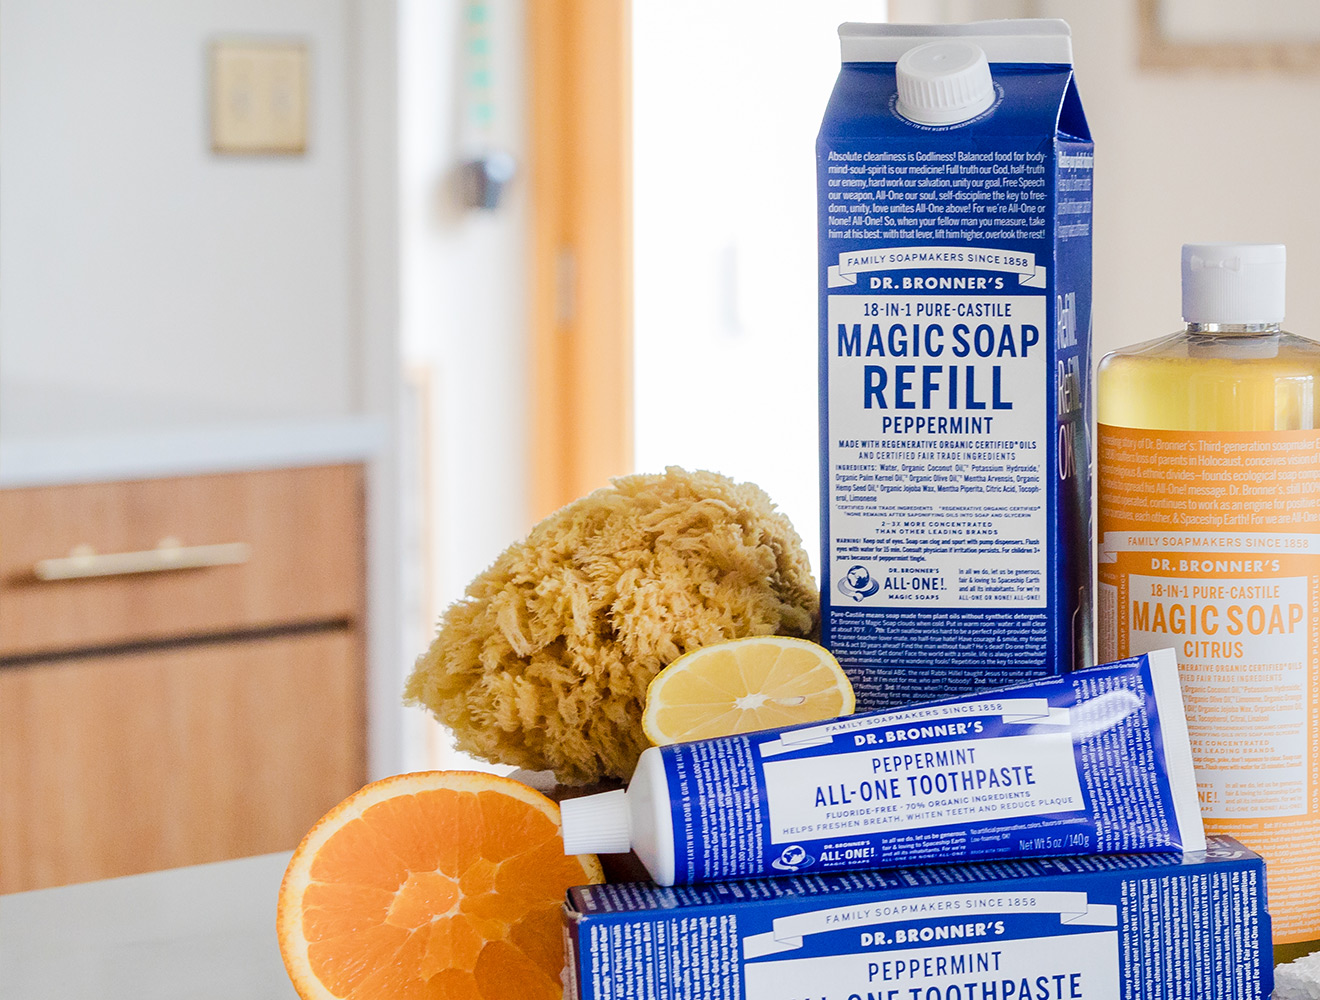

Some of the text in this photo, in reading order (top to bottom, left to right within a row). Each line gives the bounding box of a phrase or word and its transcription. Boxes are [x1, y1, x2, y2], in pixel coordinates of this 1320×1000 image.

[828, 151, 1047, 163] Absolute cleanliness is Godliness! Balanced food for body-
[848, 253, 1028, 267] FAMILY SOAPMAKERS SINCE 1858
[870, 277, 1004, 289] DR. BRONNER'S
[864, 303, 1012, 317] 18-IN-1 PURE-CASTILE
[838, 324, 1039, 358] MAGIC SOAP
[864, 365, 1013, 410] REFILL
[883, 416, 993, 434] PEPPERMINT
[839, 440, 859, 448] MADE
[861, 440, 879, 448] WITH
[882, 440, 937, 449] REGENERATIVE
[940, 441, 973, 449] ORGANIC
[1020, 441, 1037, 449] OILS
[876, 452, 915, 460] CERTIFIED
[918, 452, 934, 460] FAIR
[937, 452, 961, 460] TRADE
[964, 452, 1016, 460] INGREDIENTS
[1128, 537, 1308, 548] FAMILY SOAPMAKERS SINCE 1858
[1152, 558, 1280, 572] DR. BRONNER'S
[884, 577, 946, 590] ALL-ONE!
[1151, 584, 1279, 599] 18-IN-1 PURE-CASTILE
[1133, 600, 1219, 635] MAGIC
[1227, 604, 1302, 635] SOAP
[1184, 641, 1243, 658] CITRUS
[826, 721, 862, 731] FAMILY
[867, 710, 938, 725] SOAPMAKERS
[942, 706, 974, 714] SINCE
[854, 721, 984, 746] DR. BRONNER'S
[872, 748, 975, 774] PEPPERMINT
[816, 766, 1036, 807] ALL-ONE TOOTHPASTE
[826, 805, 897, 819] FLUORIDE-FREE
[928, 797, 968, 807] ORGANIC
[972, 791, 1030, 802] INGREDIENTS
[783, 797, 1073, 834] HELPS FRESHEN BREATH, WHITEN TEETH AND REDUCE PLAQUE
[820, 847, 874, 862] ALL-ONE!
[826, 898, 1036, 923] FAMILY SOAPMAKERS SINCE 1858
[861, 921, 1005, 946] DR. BRONNER'S
[869, 951, 1002, 982] PEPPERMINT
